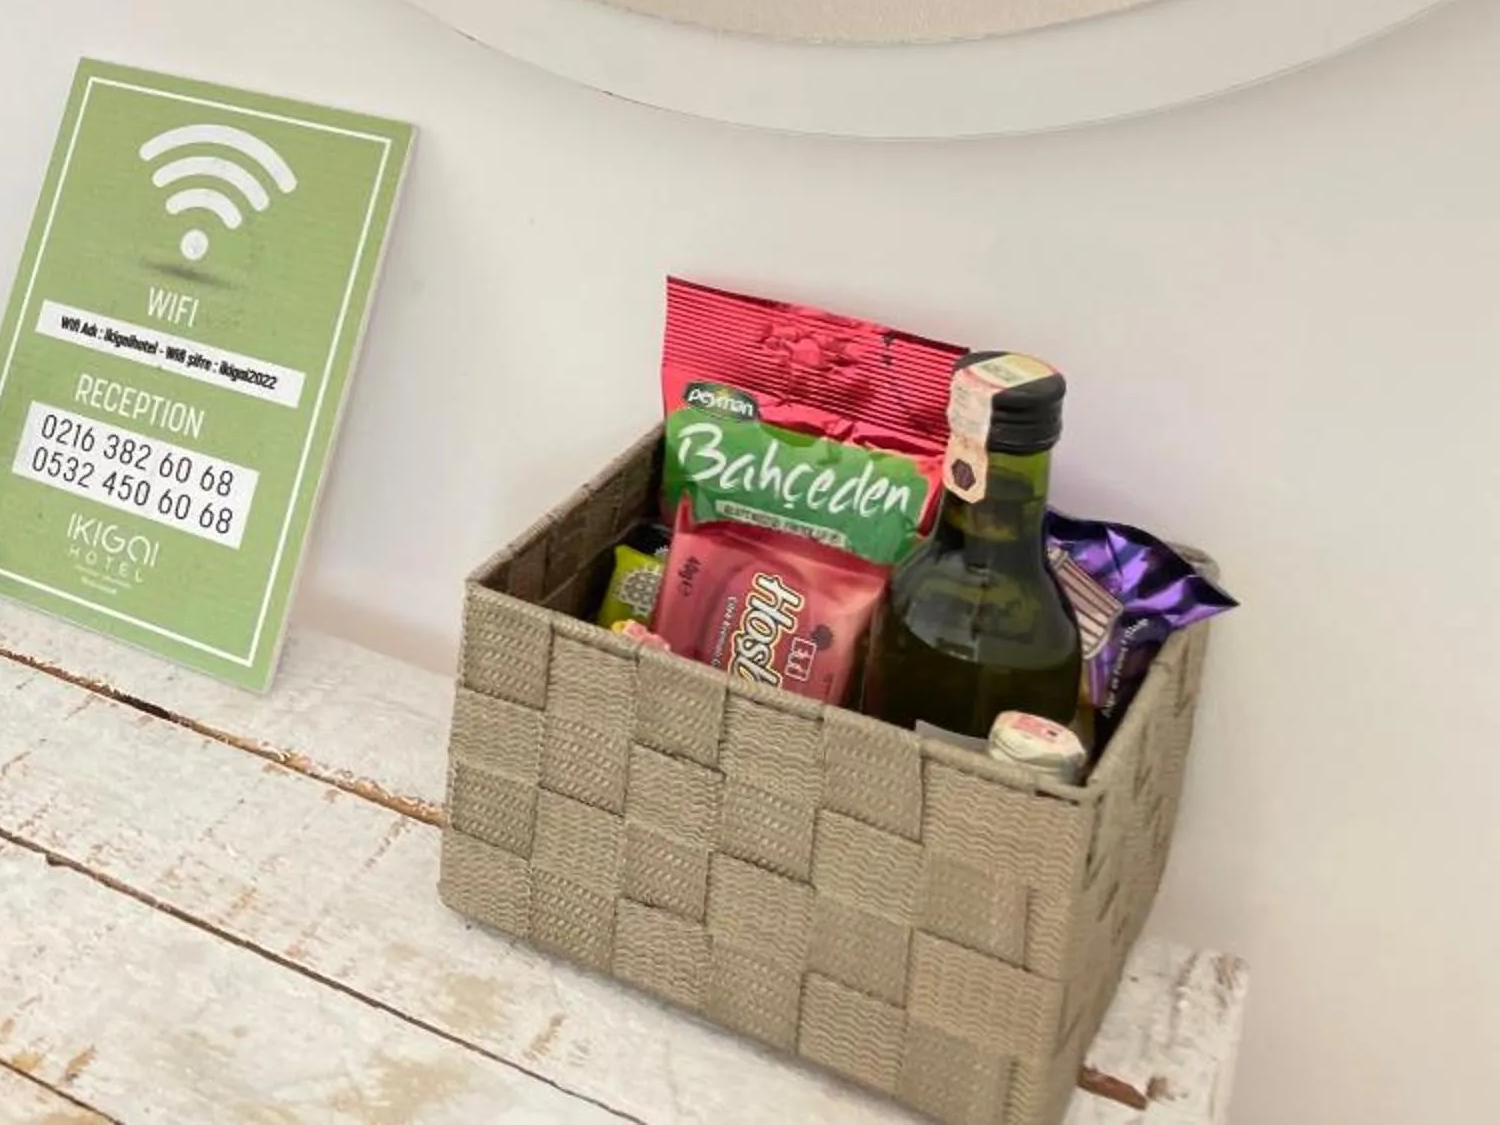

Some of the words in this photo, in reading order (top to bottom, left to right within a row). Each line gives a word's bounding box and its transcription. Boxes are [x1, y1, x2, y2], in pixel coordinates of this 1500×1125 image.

[147, 286, 199, 327] WIFI
[75, 373, 205, 440] RECEPTION
[688, 388, 753, 417] peyman
[41, 414, 95, 452] 0216
[103, 434, 152, 470] 382
[159, 452, 192, 483] 60
[200, 465, 234, 497] 68
[678, 422, 912, 517] Bahçeden
[32, 446, 95, 488] 0532
[102, 471, 151, 506] 450
[157, 488, 191, 520] 60
[199, 503, 233, 534] 68
[69, 546, 144, 582] HOTEL
